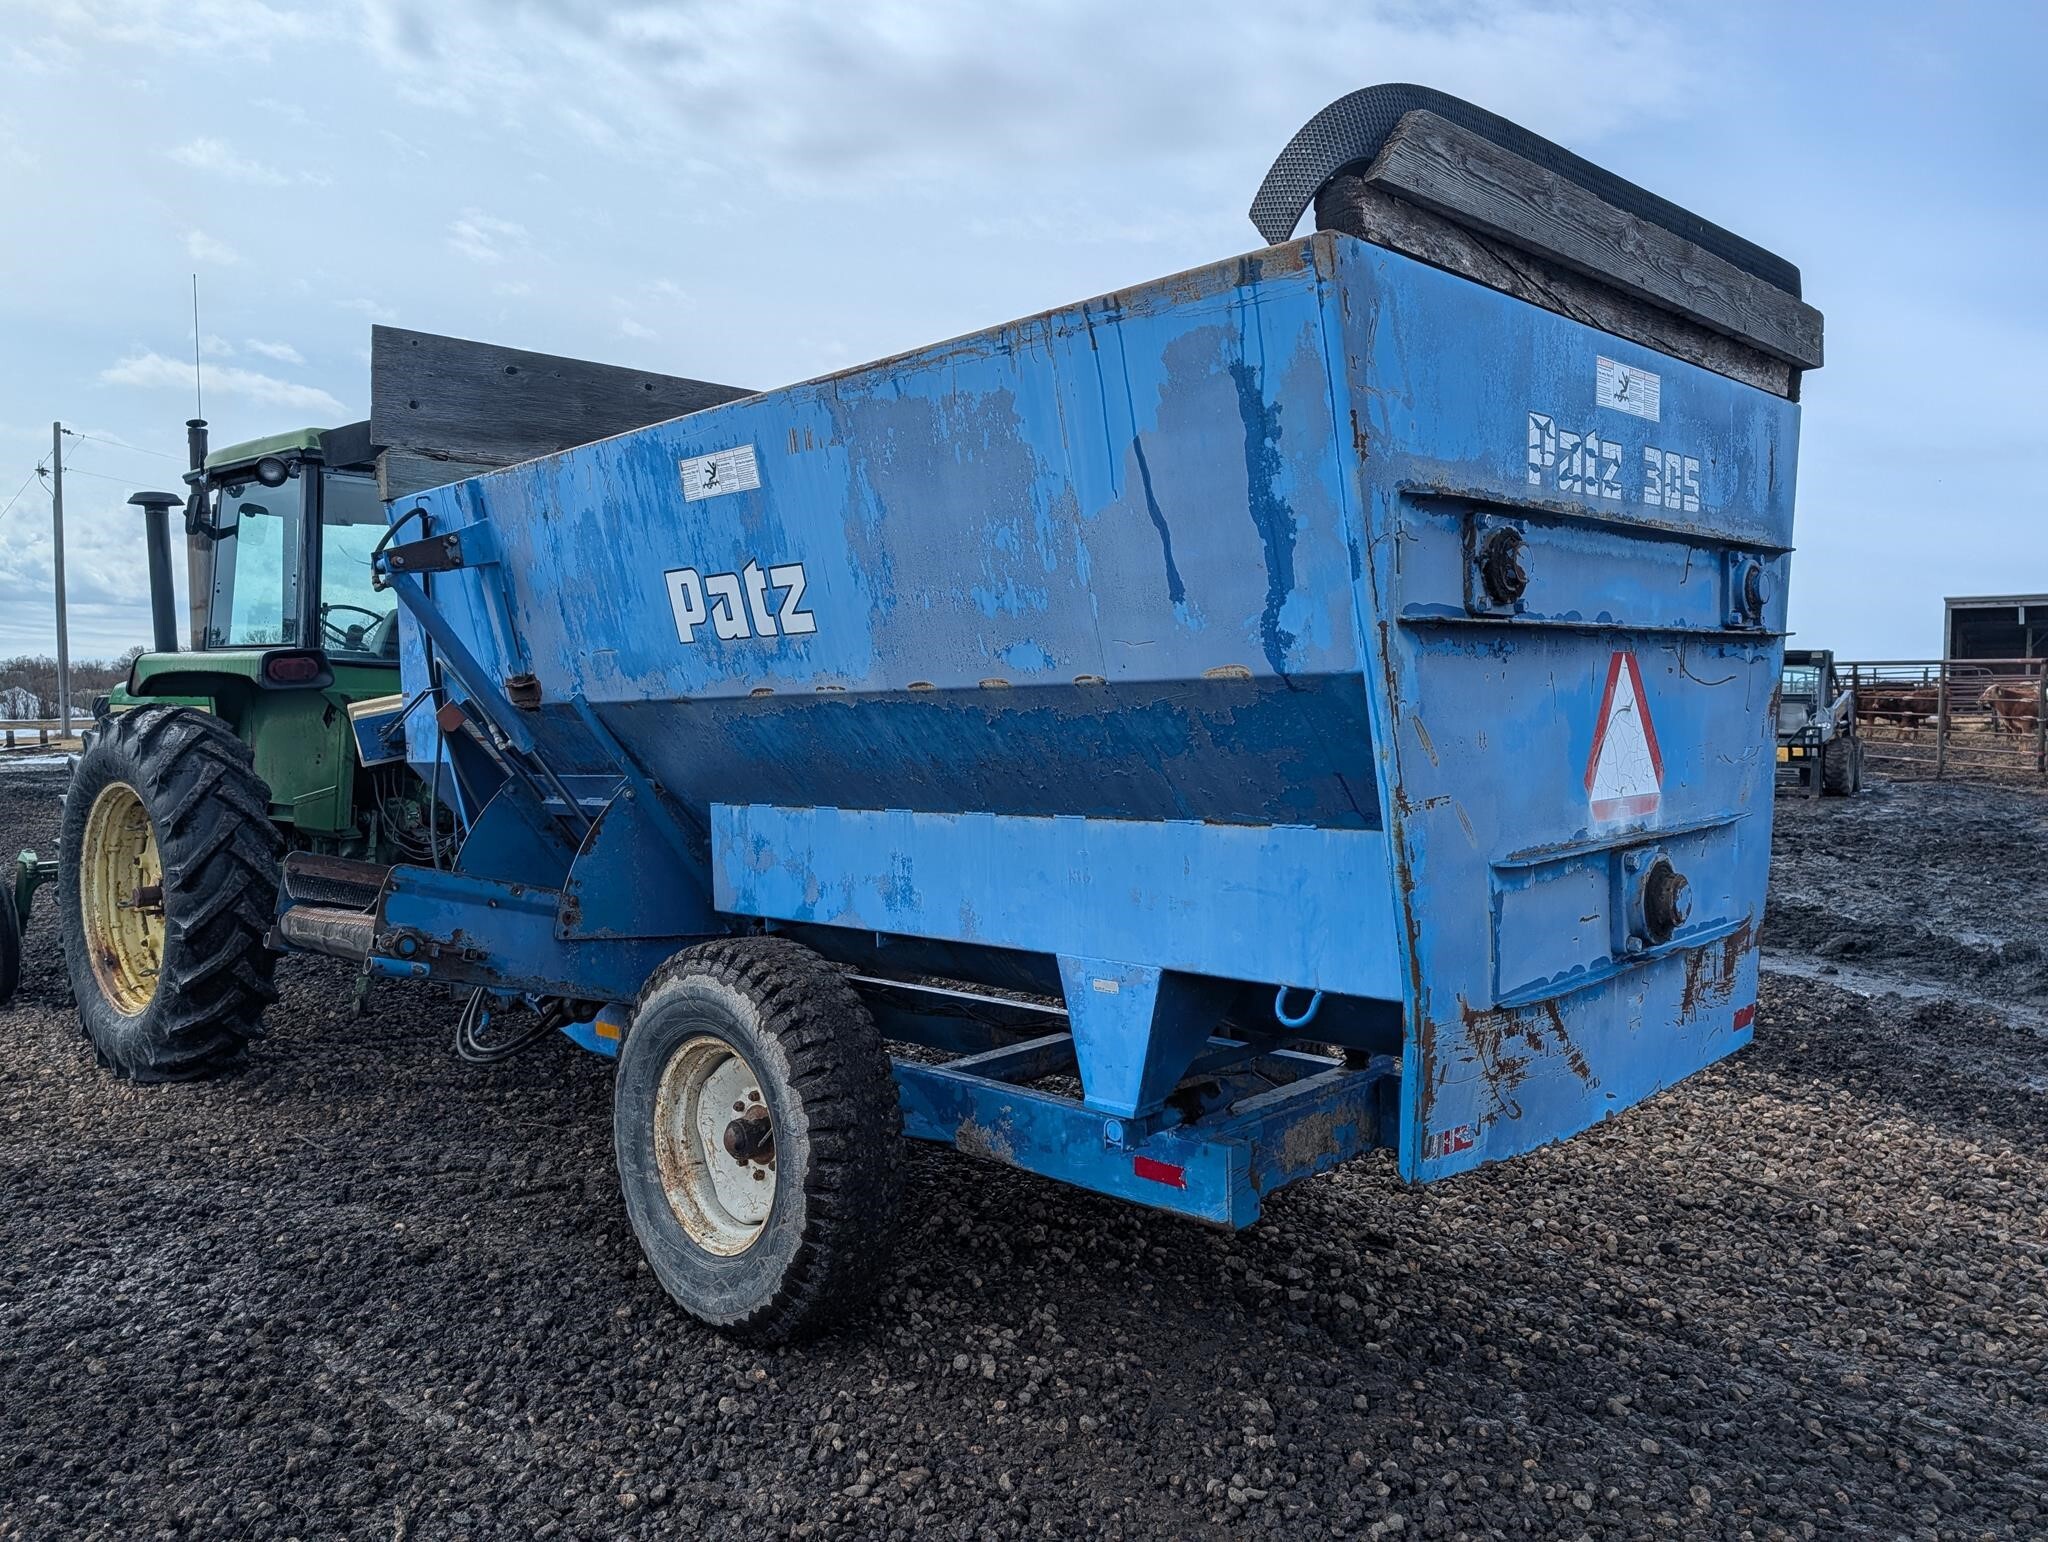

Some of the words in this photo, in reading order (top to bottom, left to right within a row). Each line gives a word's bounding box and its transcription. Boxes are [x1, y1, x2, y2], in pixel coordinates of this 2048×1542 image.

[1528, 410, 1623, 500] Patz
[1644, 445, 1700, 513] 305
[664, 557, 818, 644] Patz
